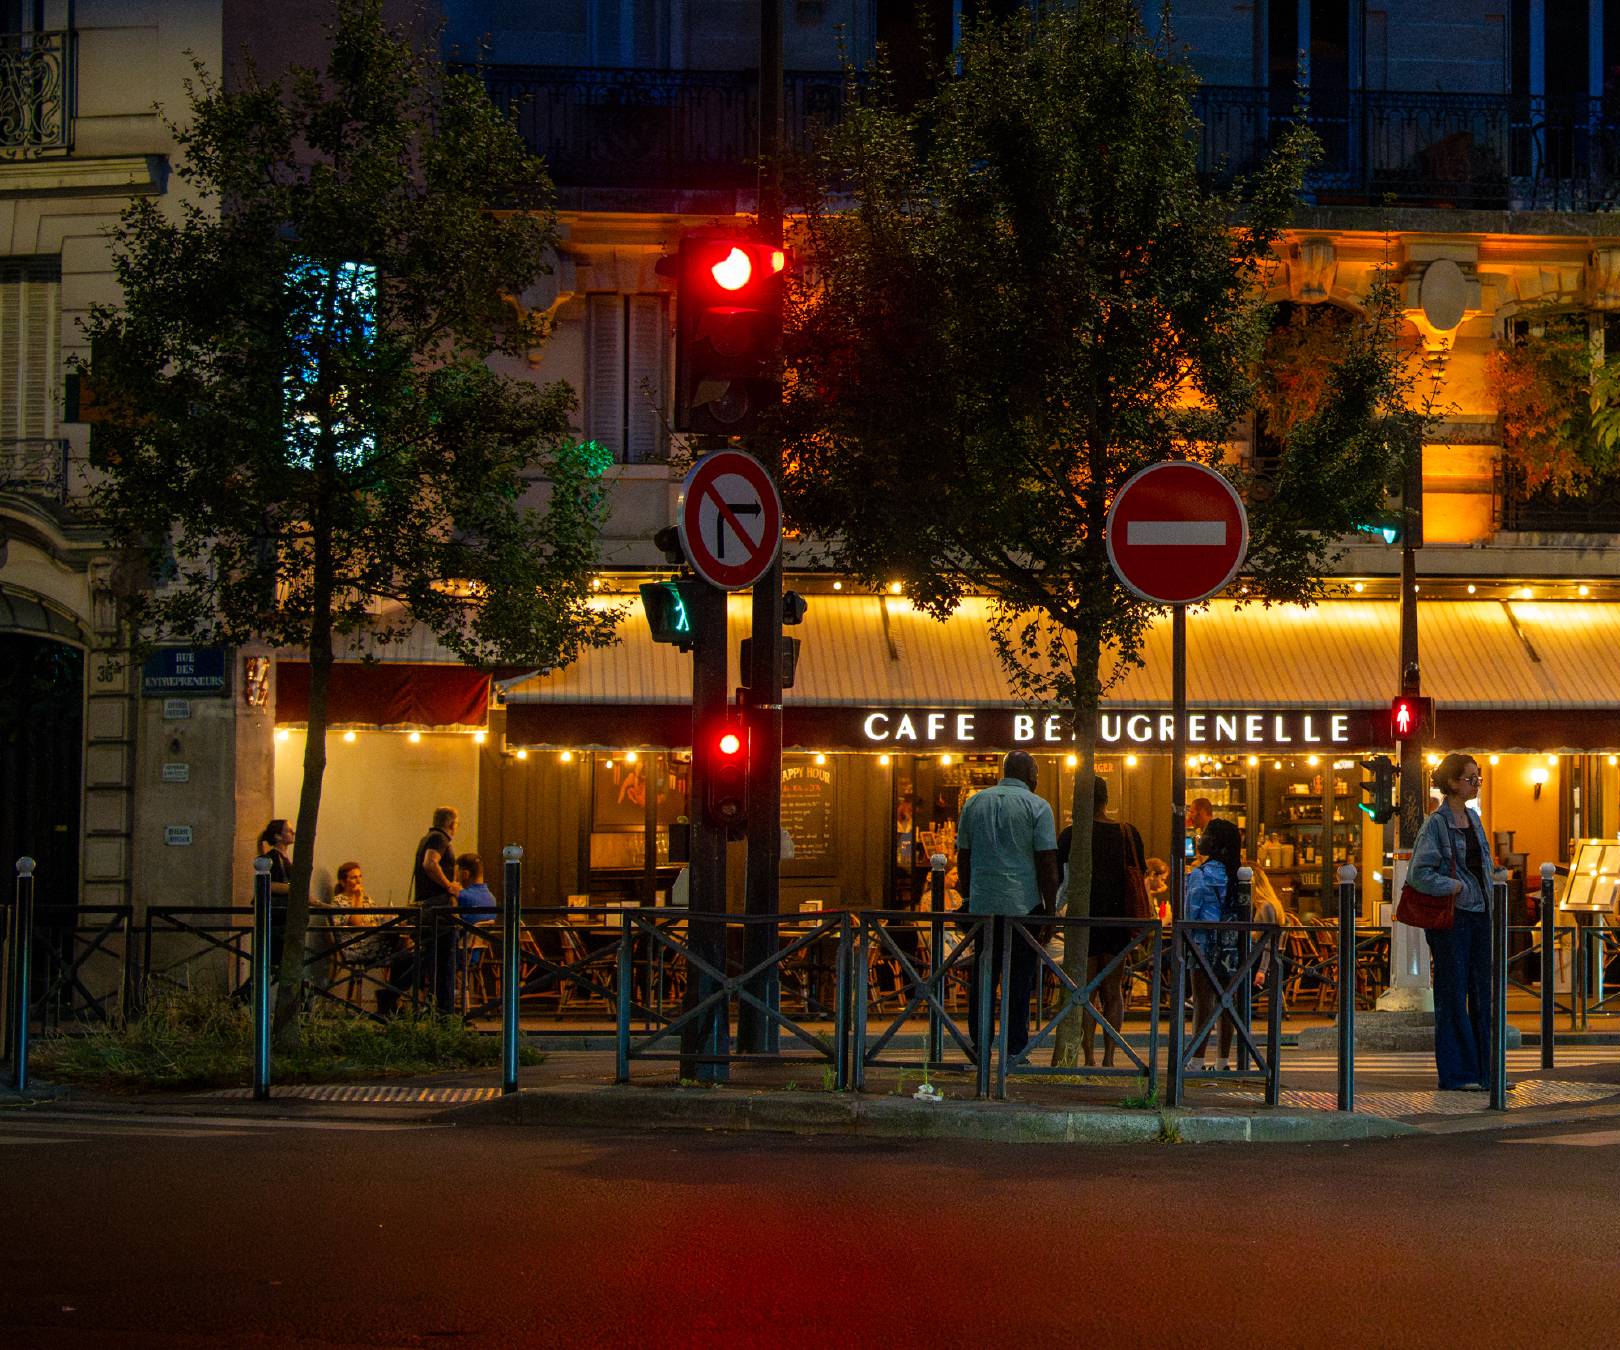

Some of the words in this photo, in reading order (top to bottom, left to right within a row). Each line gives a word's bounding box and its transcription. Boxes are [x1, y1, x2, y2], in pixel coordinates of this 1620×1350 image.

[175, 652, 195, 663] RUE
[175, 664, 195, 675] DES
[145, 676, 225, 687] ENTREPRENEURS
[863, 713, 975, 742] CAFE
[1014, 714, 1349, 743] BEUGRENELLE
[782, 767, 804, 783] APPY
[806, 767, 831, 785] HOUR
